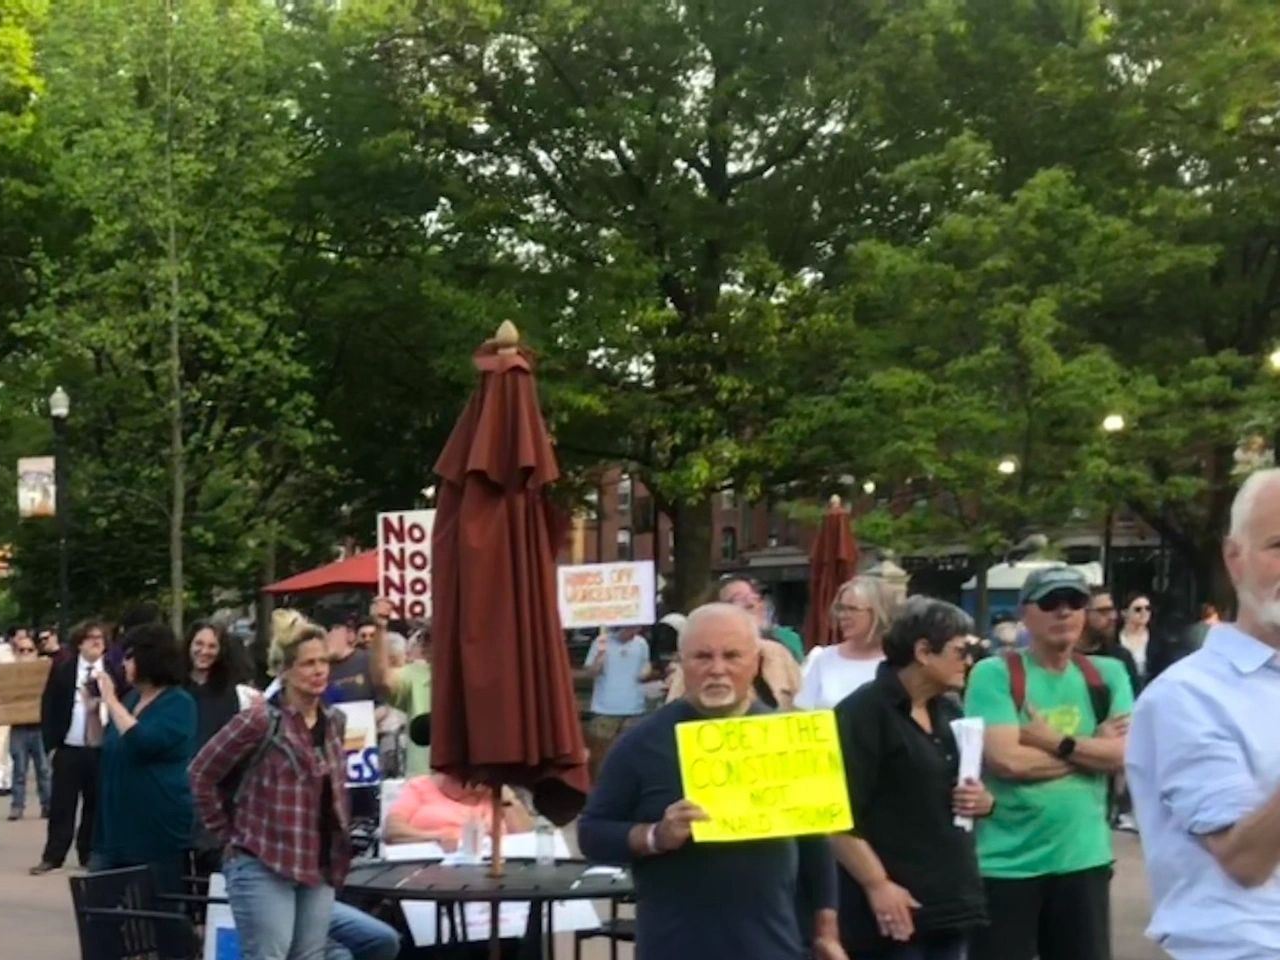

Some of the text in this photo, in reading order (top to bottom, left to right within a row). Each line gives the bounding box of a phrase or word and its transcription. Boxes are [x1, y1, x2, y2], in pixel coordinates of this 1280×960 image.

[383, 515, 425, 545] NO
[383, 547, 427, 572] NO
[383, 573, 427, 597] NO
[780, 714, 829, 743] THE
